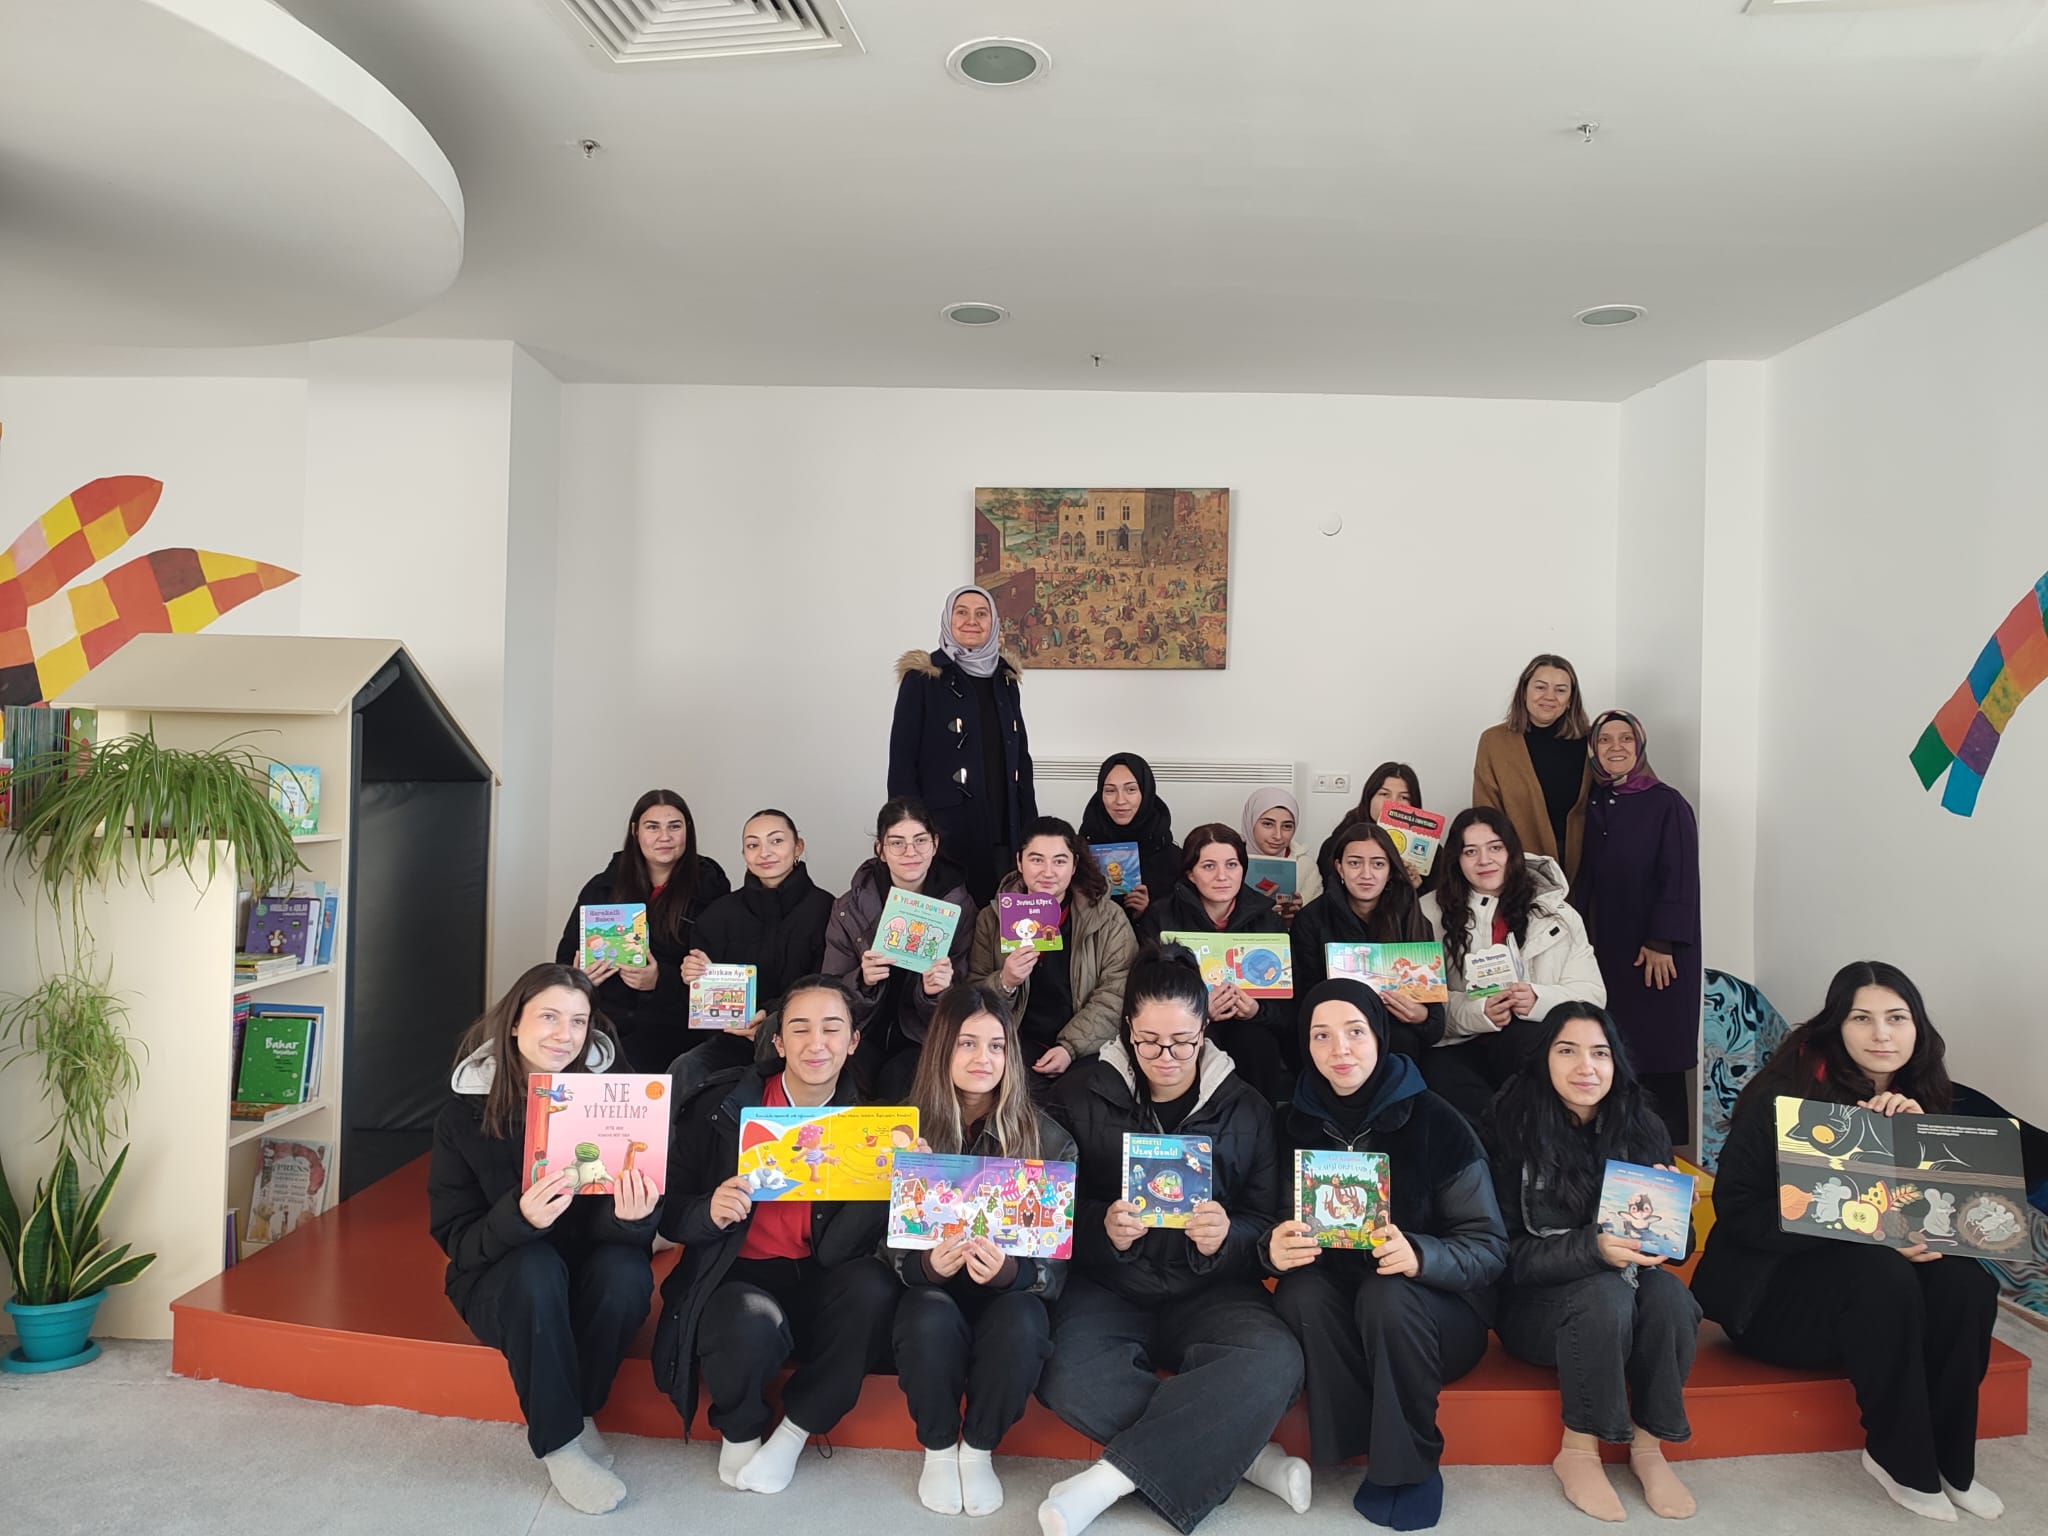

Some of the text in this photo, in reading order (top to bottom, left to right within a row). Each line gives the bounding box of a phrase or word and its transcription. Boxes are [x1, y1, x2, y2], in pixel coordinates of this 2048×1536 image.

[265, 1037, 300, 1049] Bahar
[603, 1083, 631, 1103] NE
[584, 1103, 648, 1119] YİYELİM?
